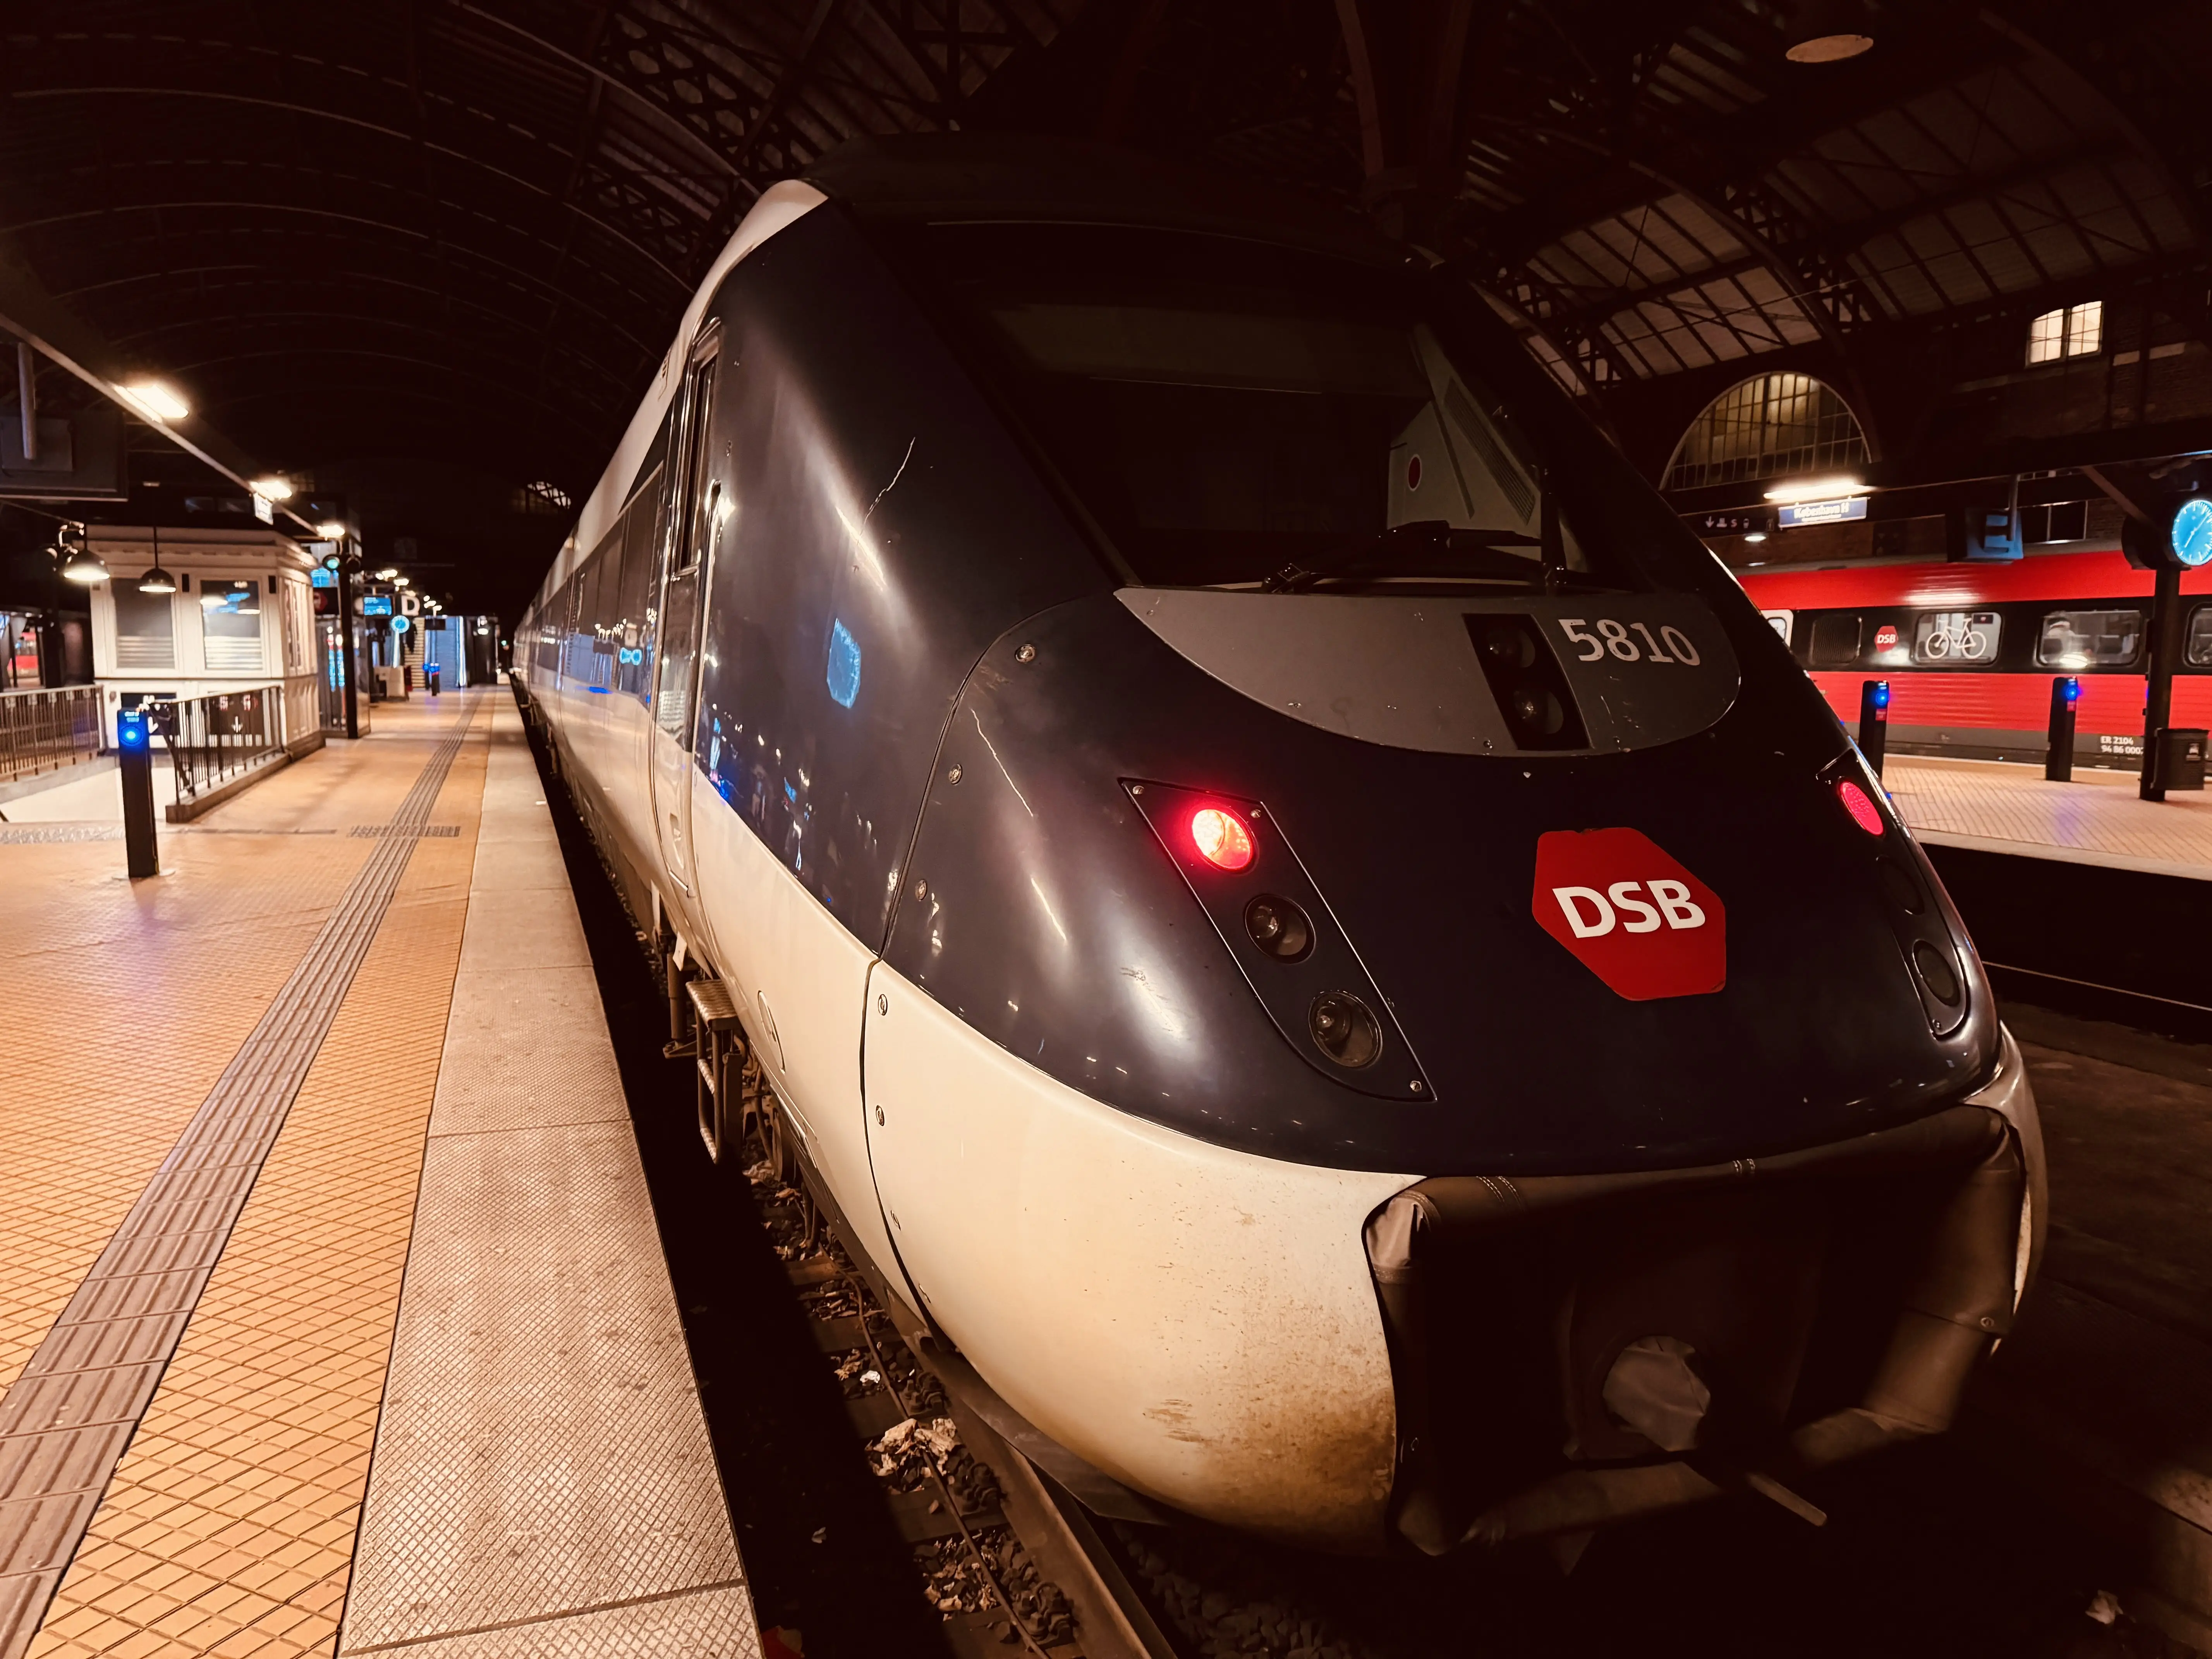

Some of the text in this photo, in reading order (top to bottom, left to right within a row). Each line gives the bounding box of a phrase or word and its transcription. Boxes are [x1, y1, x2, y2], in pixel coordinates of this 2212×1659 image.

[401, 595, 420, 616] D
[1558, 619, 1700, 666] 5810
[1877, 634, 1896, 644] DSB
[2100, 736, 2134, 745] ER 2104
[2100, 745, 2112, 753] 94
[1552, 880, 1705, 938] DSB
